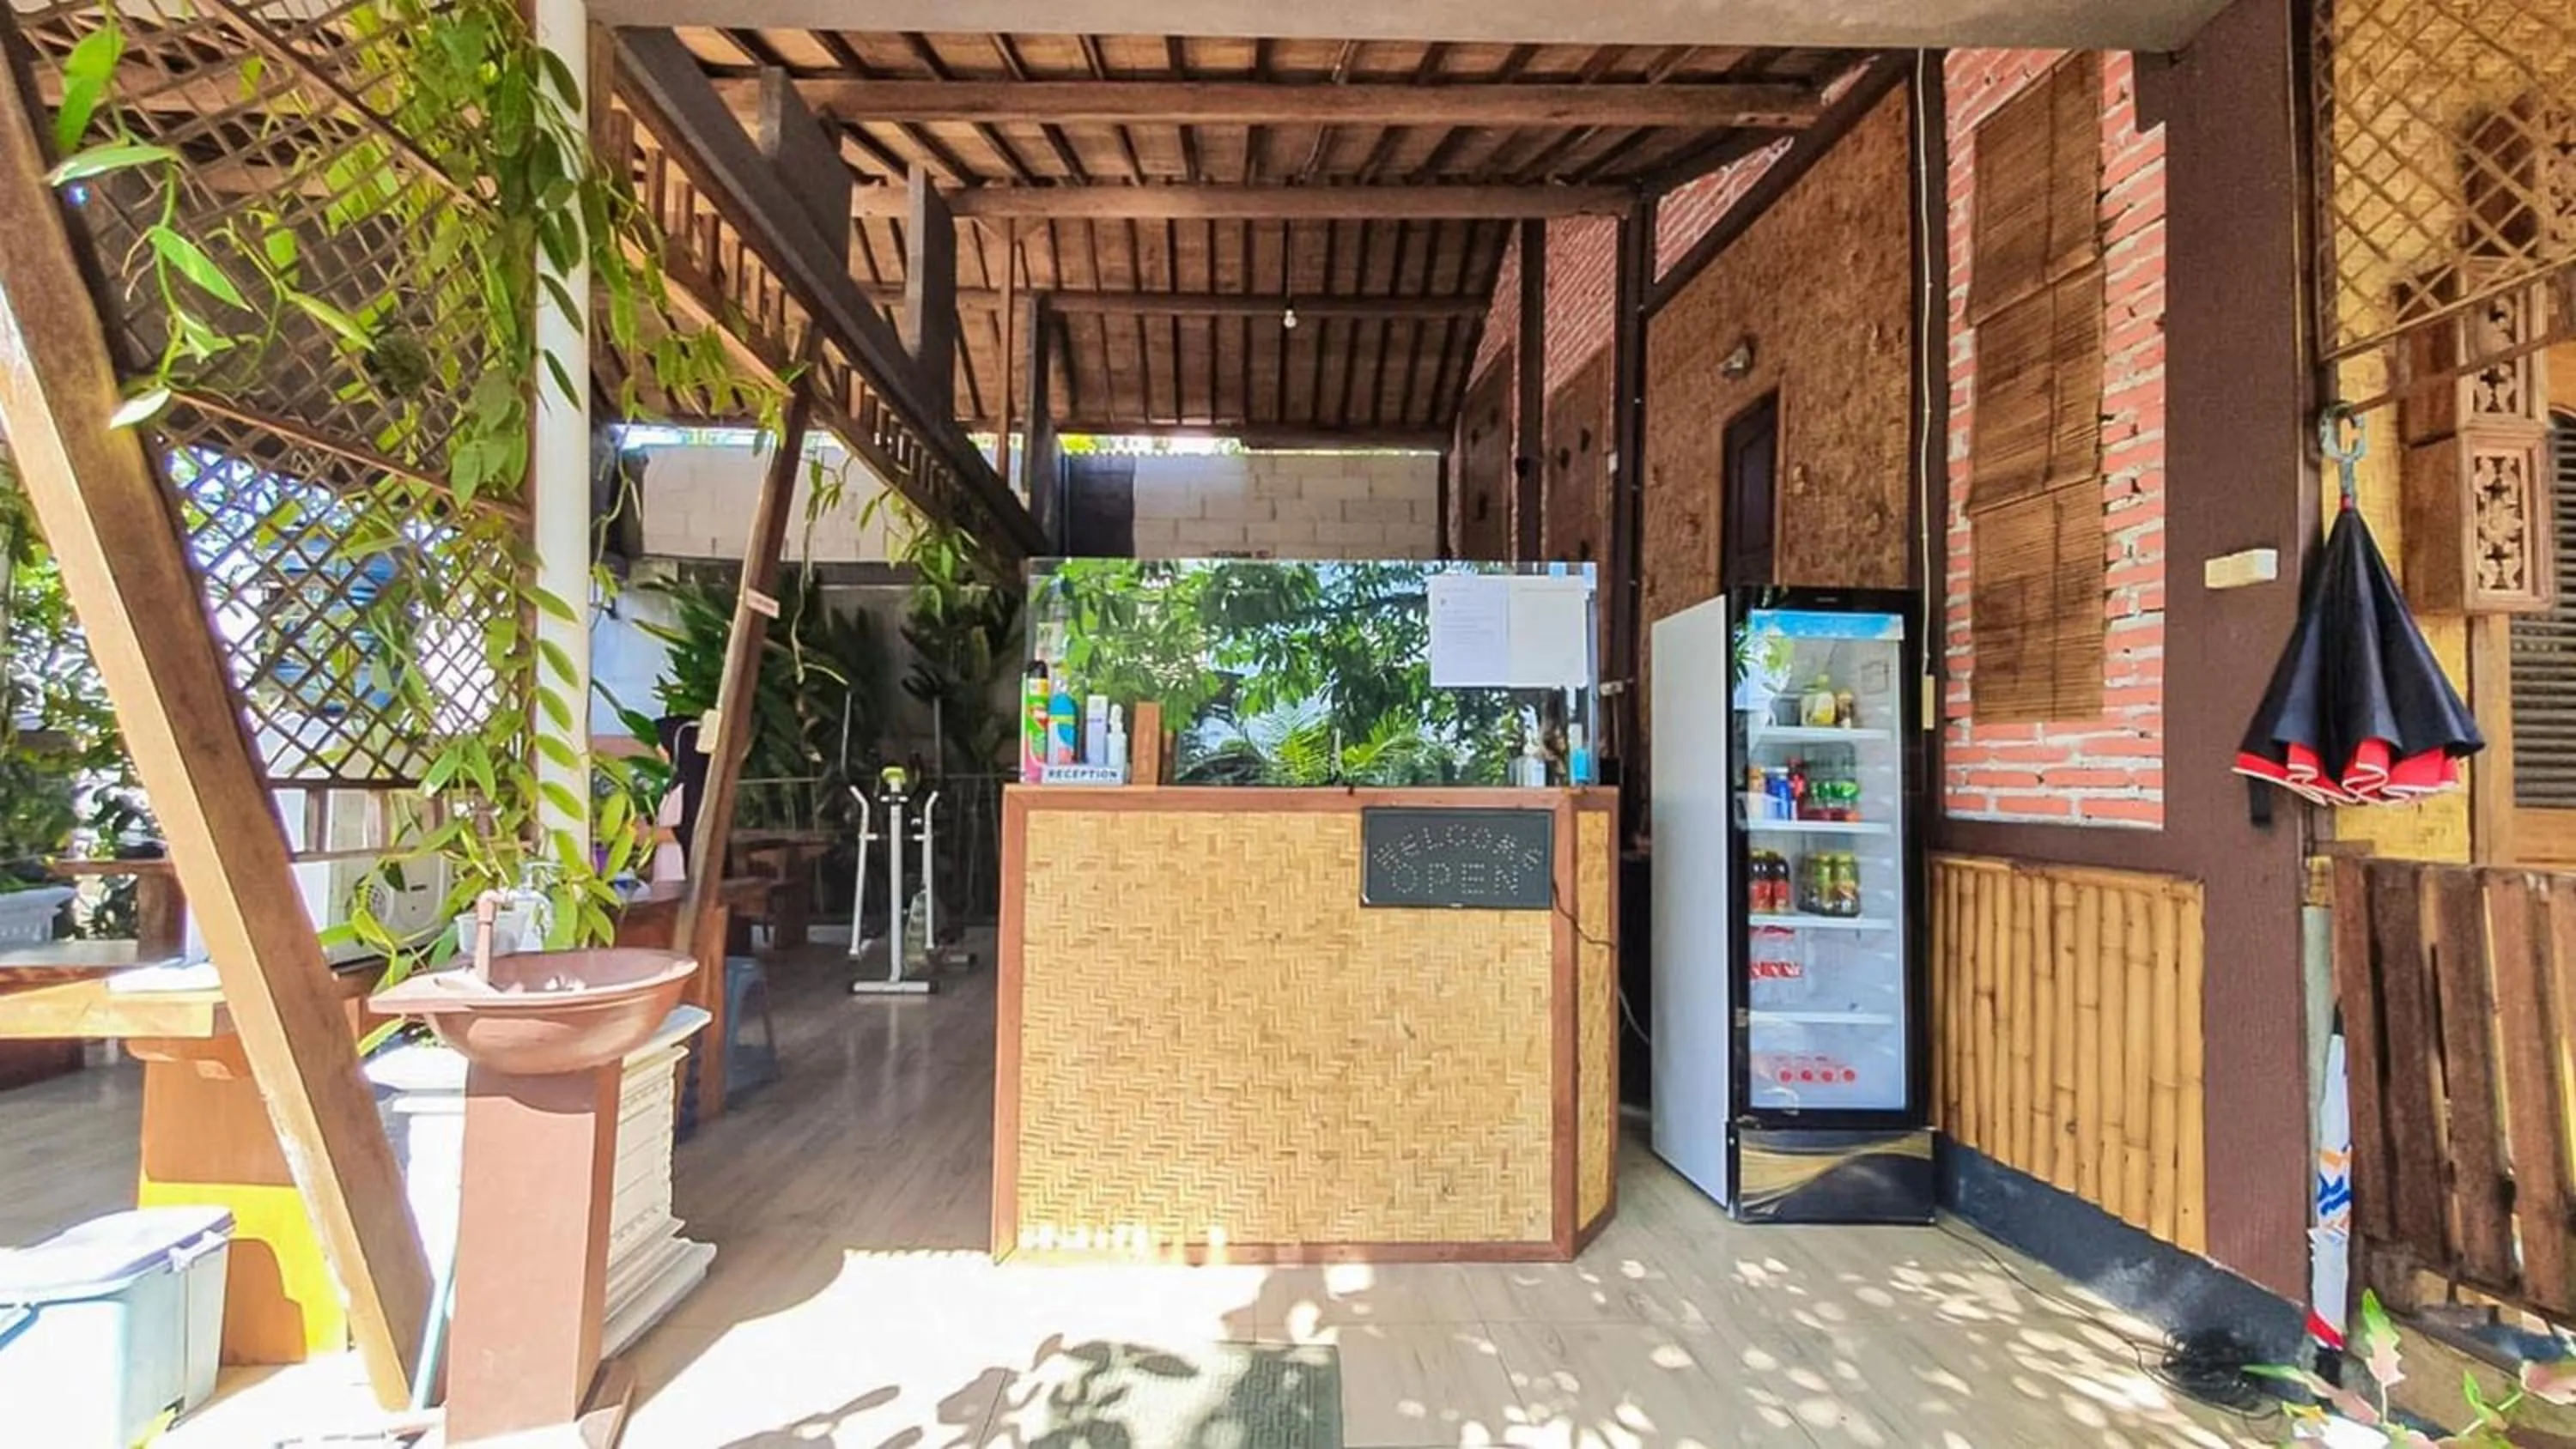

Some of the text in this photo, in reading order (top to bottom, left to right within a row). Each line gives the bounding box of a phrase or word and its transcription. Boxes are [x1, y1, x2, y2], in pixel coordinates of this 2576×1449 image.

[1048, 768, 1118, 779] RECEPTION
[1373, 823, 1544, 871] WELCOME
[1391, 861, 1519, 896] OPEN
